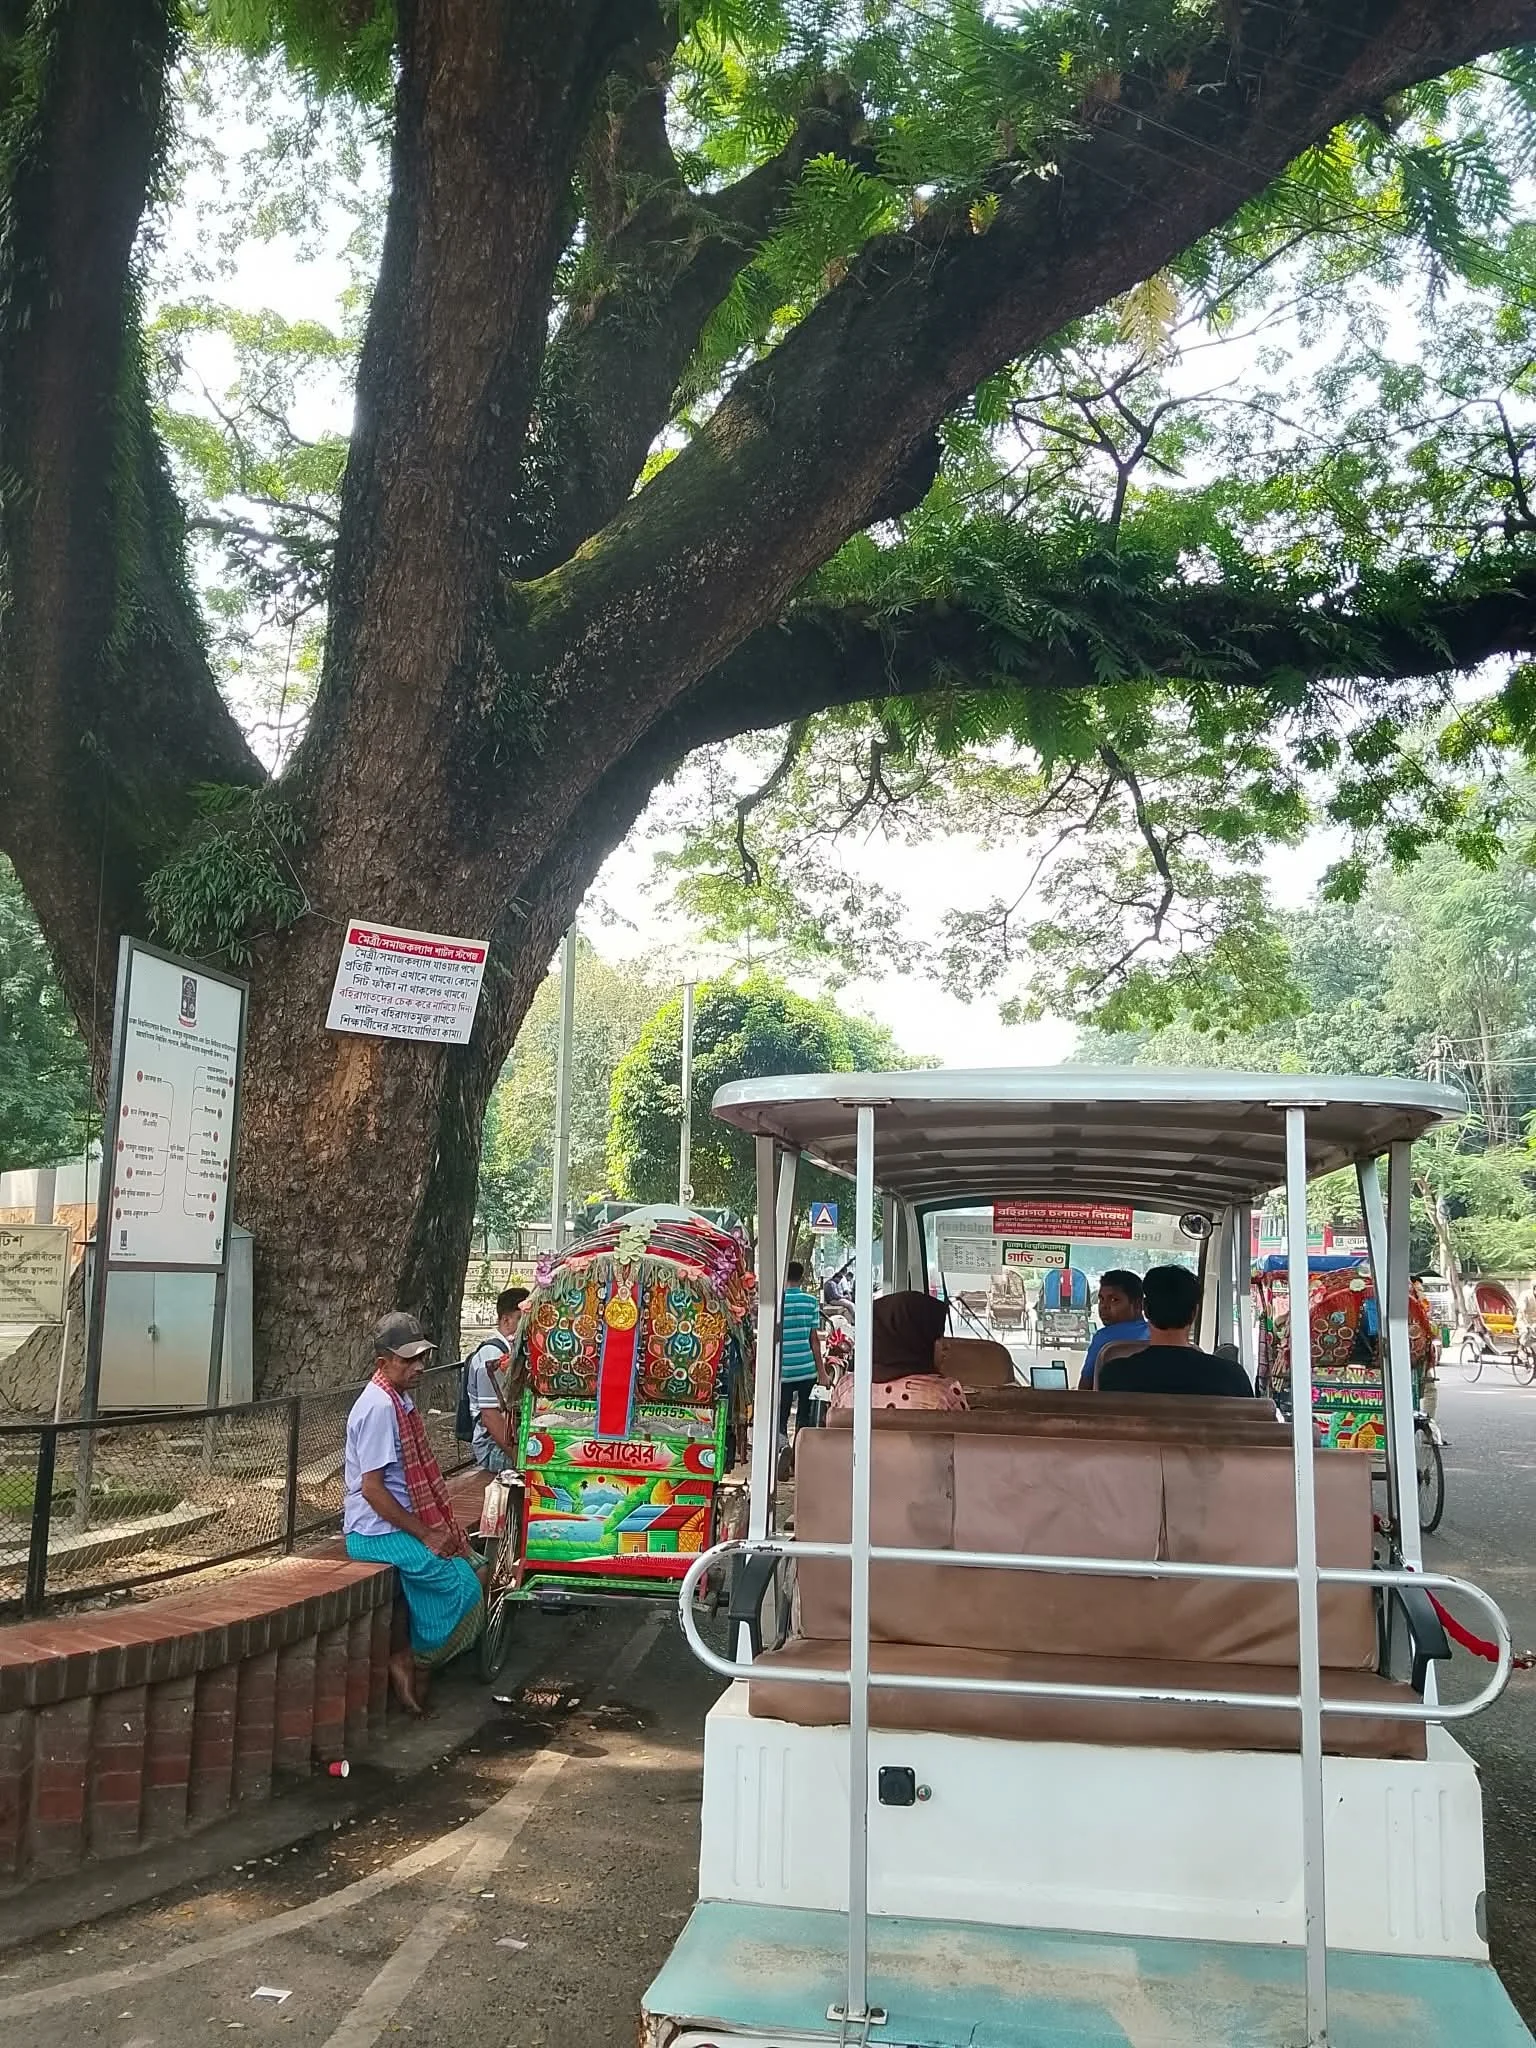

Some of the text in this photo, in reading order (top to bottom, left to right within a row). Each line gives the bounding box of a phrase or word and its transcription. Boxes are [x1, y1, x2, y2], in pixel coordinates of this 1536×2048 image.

[435, 947, 454, 958] শাটল
[345, 960, 371, 973] প্রতিটি
[374, 966, 398, 978] শাটল
[400, 968, 428, 981] এখানে
[454, 976, 479, 988] কোনো
[434, 960, 460, 972] যাওয়ার
[461, 962, 476, 975] পথে
[353, 974, 369, 986] সিট
[372, 977, 395, 990] ফাঁকা
[398, 982, 407, 992] না
[409, 984, 441, 997] থাকলেও
[339, 987, 392, 1005] বহিরাগতদের
[394, 995, 413, 1007] চেক
[415, 998, 431, 1010] করে
[354, 1004, 378, 1016] শাটল
[432, 1013, 456, 1025] রাখতে
[339, 1014, 388, 1032] শিক্ষার্থীদের
[998, 1206, 1129, 1220] বহিরাগত চলাচল নিষেধ।
[0, 1231, 24, 1248] টিশ
[1025, 1243, 1067, 1251] বিশ্ববিদ্যালয়
[1007, 1251, 1035, 1265] গাড়ি
[1045, 1255, 1064, 1264] ০৩
[565, 1400, 596, 1412] 0191
